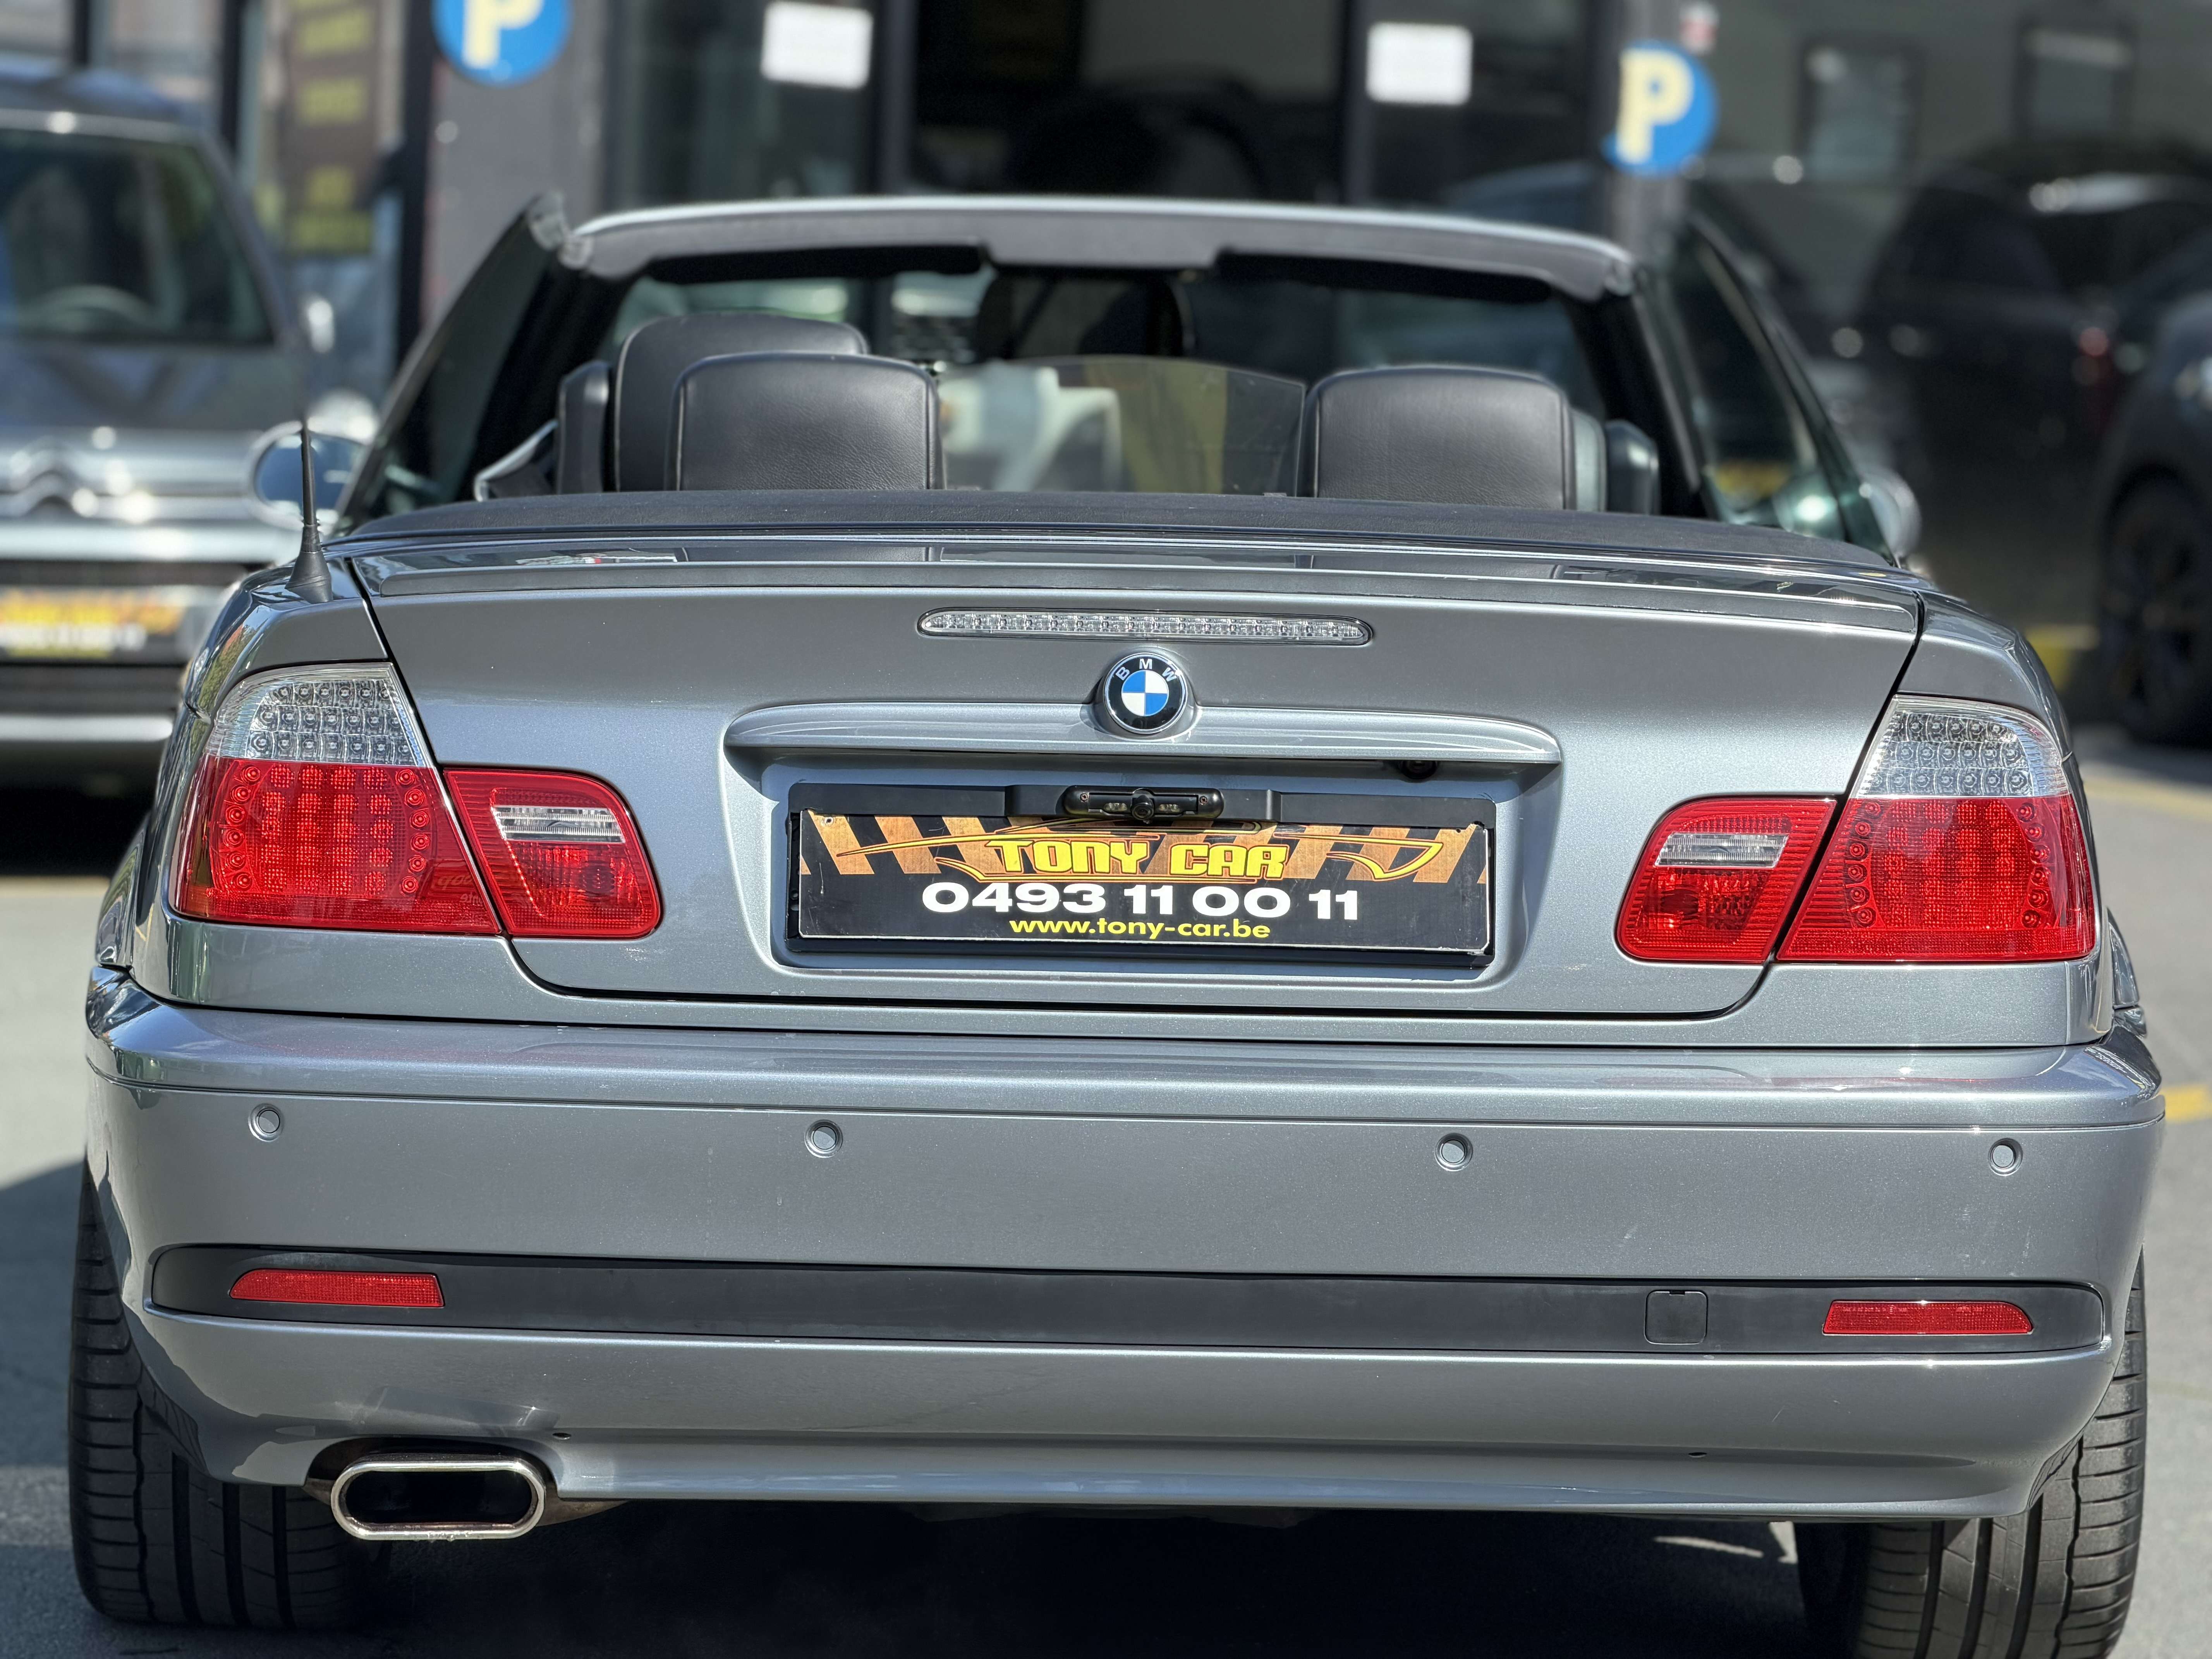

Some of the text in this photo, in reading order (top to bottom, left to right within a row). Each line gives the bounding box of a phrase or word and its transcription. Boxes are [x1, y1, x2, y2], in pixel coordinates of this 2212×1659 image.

[463, 0, 543, 69] P
[1616, 48, 1695, 163] P
[1116, 658, 1176, 682] BMW
[986, 840, 1289, 878] TONY CAR
[922, 882, 1357, 920] 0493 11 00 11
[1009, 918, 1271, 939] www.tony-car.be
